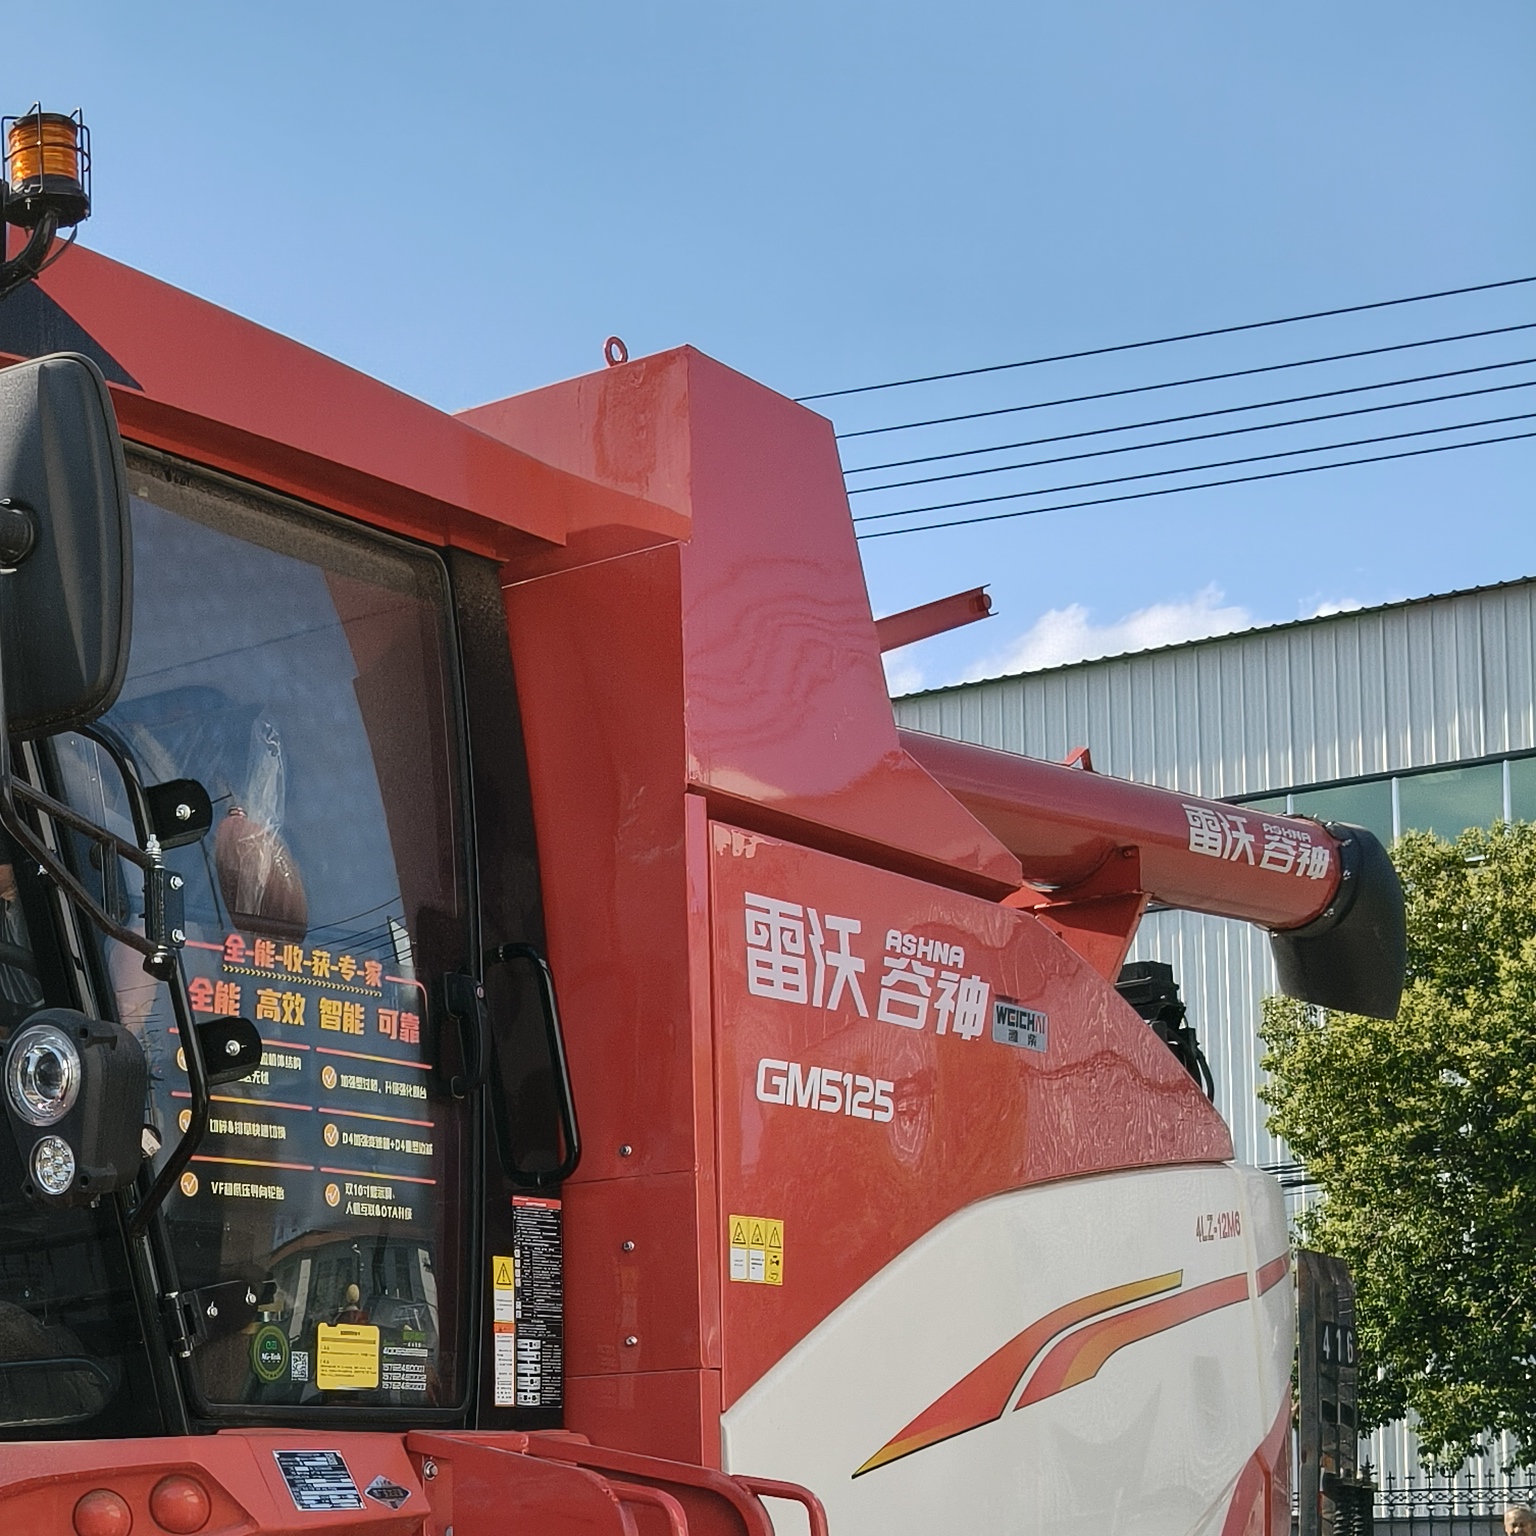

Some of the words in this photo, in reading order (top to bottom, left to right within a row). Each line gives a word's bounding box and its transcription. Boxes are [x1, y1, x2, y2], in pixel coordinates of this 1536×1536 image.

[1181, 803, 1255, 866] 雷沃
[1259, 835, 1330, 880] 谷神
[1262, 822, 1312, 844] ASHNA
[745, 892, 869, 1018] 雷沃
[877, 957, 990, 1041] 谷神
[885, 929, 965, 969] ASHNA
[187, 977, 242, 1018] 全能
[256, 988, 307, 1026] 高效
[319, 996, 365, 1035] 智能
[378, 1007, 421, 1044] 可靠
[996, 1005, 1046, 1035] WEICHAI
[756, 1058, 894, 1123] GM5125
